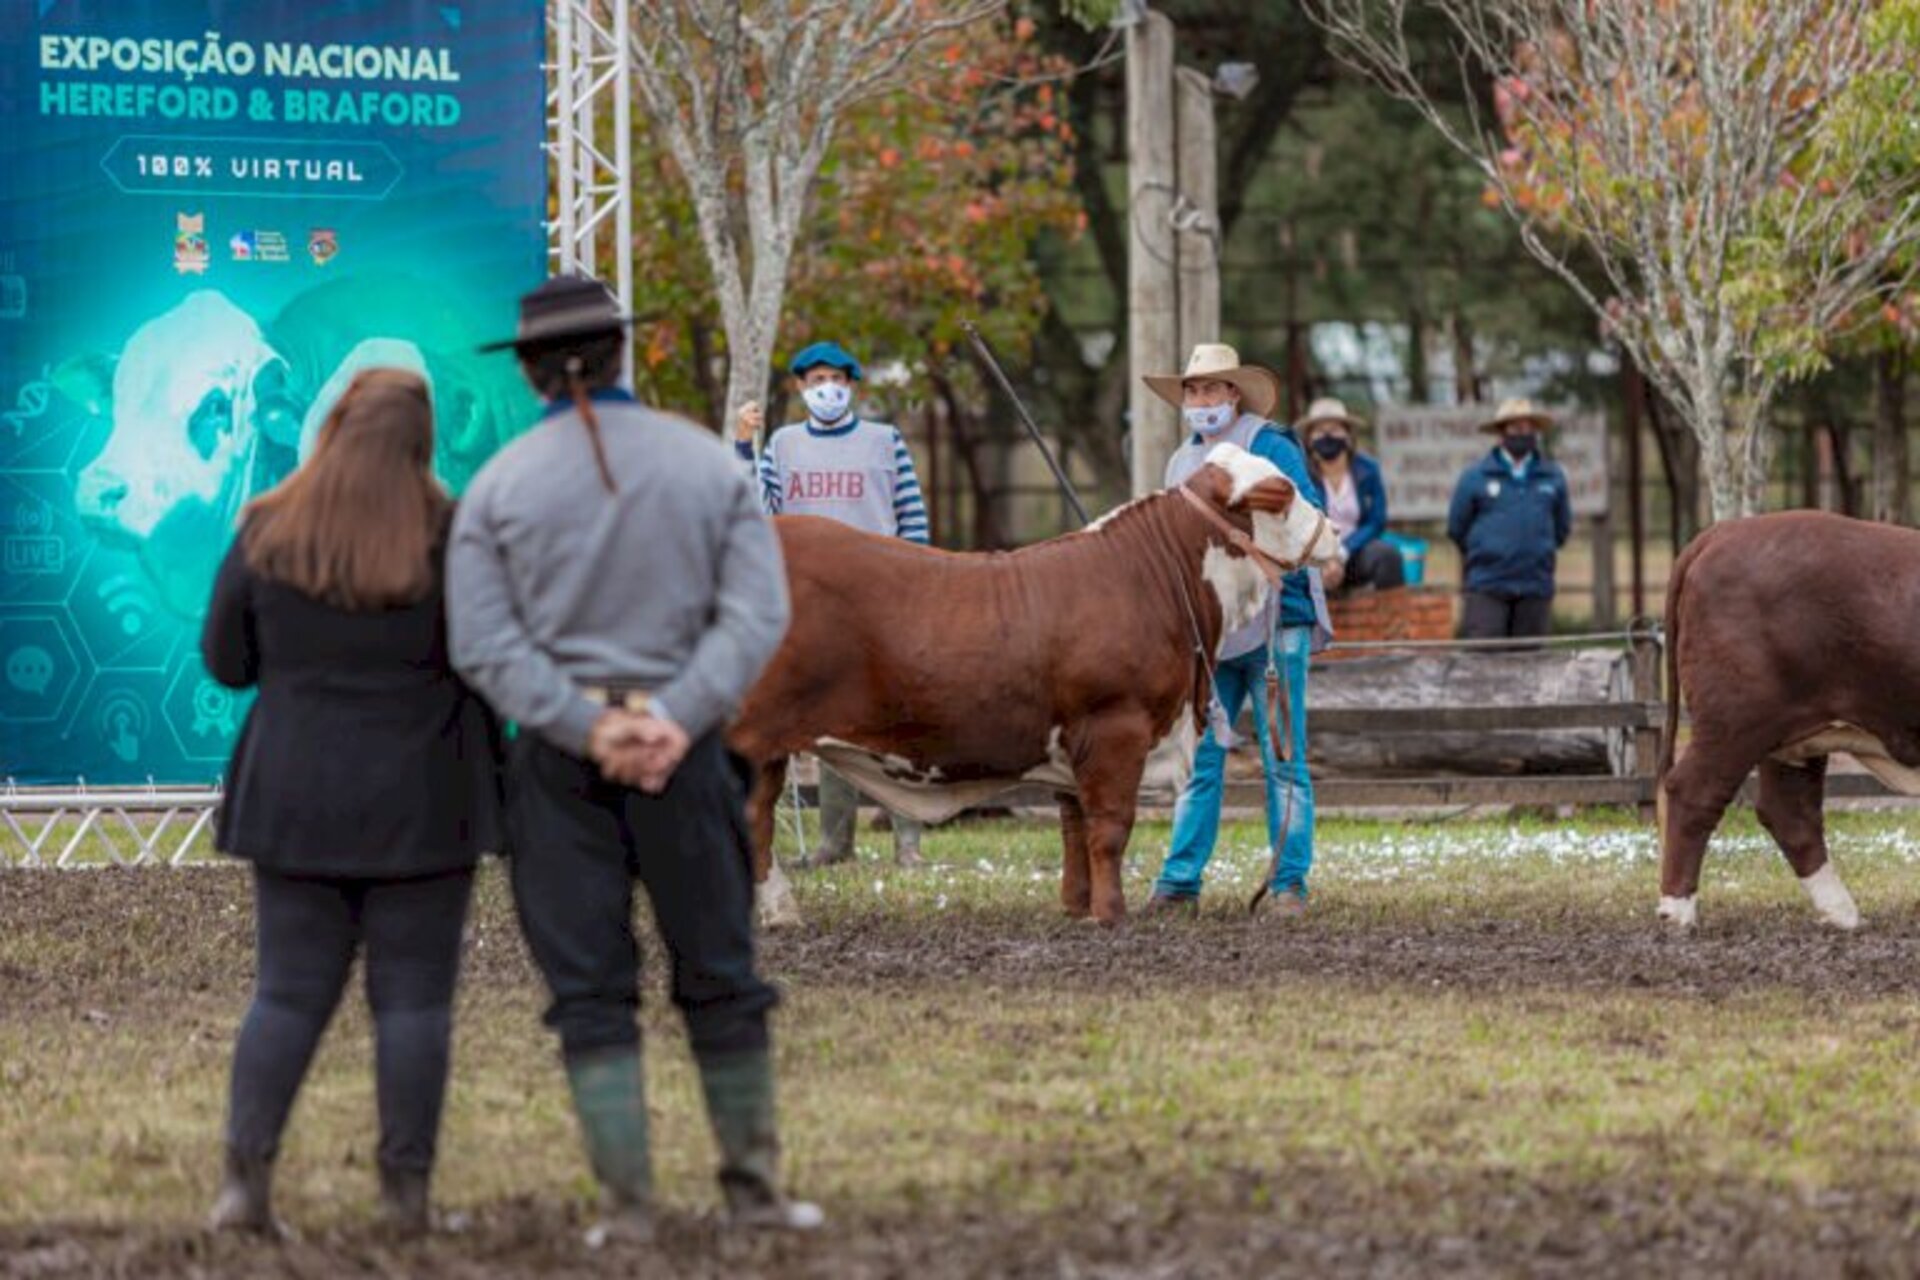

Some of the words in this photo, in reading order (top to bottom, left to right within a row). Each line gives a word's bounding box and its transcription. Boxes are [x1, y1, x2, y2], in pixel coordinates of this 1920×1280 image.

[39, 32, 255, 80] EXPOSIÇÃO
[264, 45, 460, 82] NACIONAL
[39, 83, 238, 121] HEREFORD
[248, 90, 275, 122] &
[284, 92, 460, 127] BRAFORD
[137, 154, 213, 178] 100%
[231, 158, 364, 181] VIRTUAL
[787, 472, 864, 501] ABHB
[12, 541, 59, 566] LIVE
